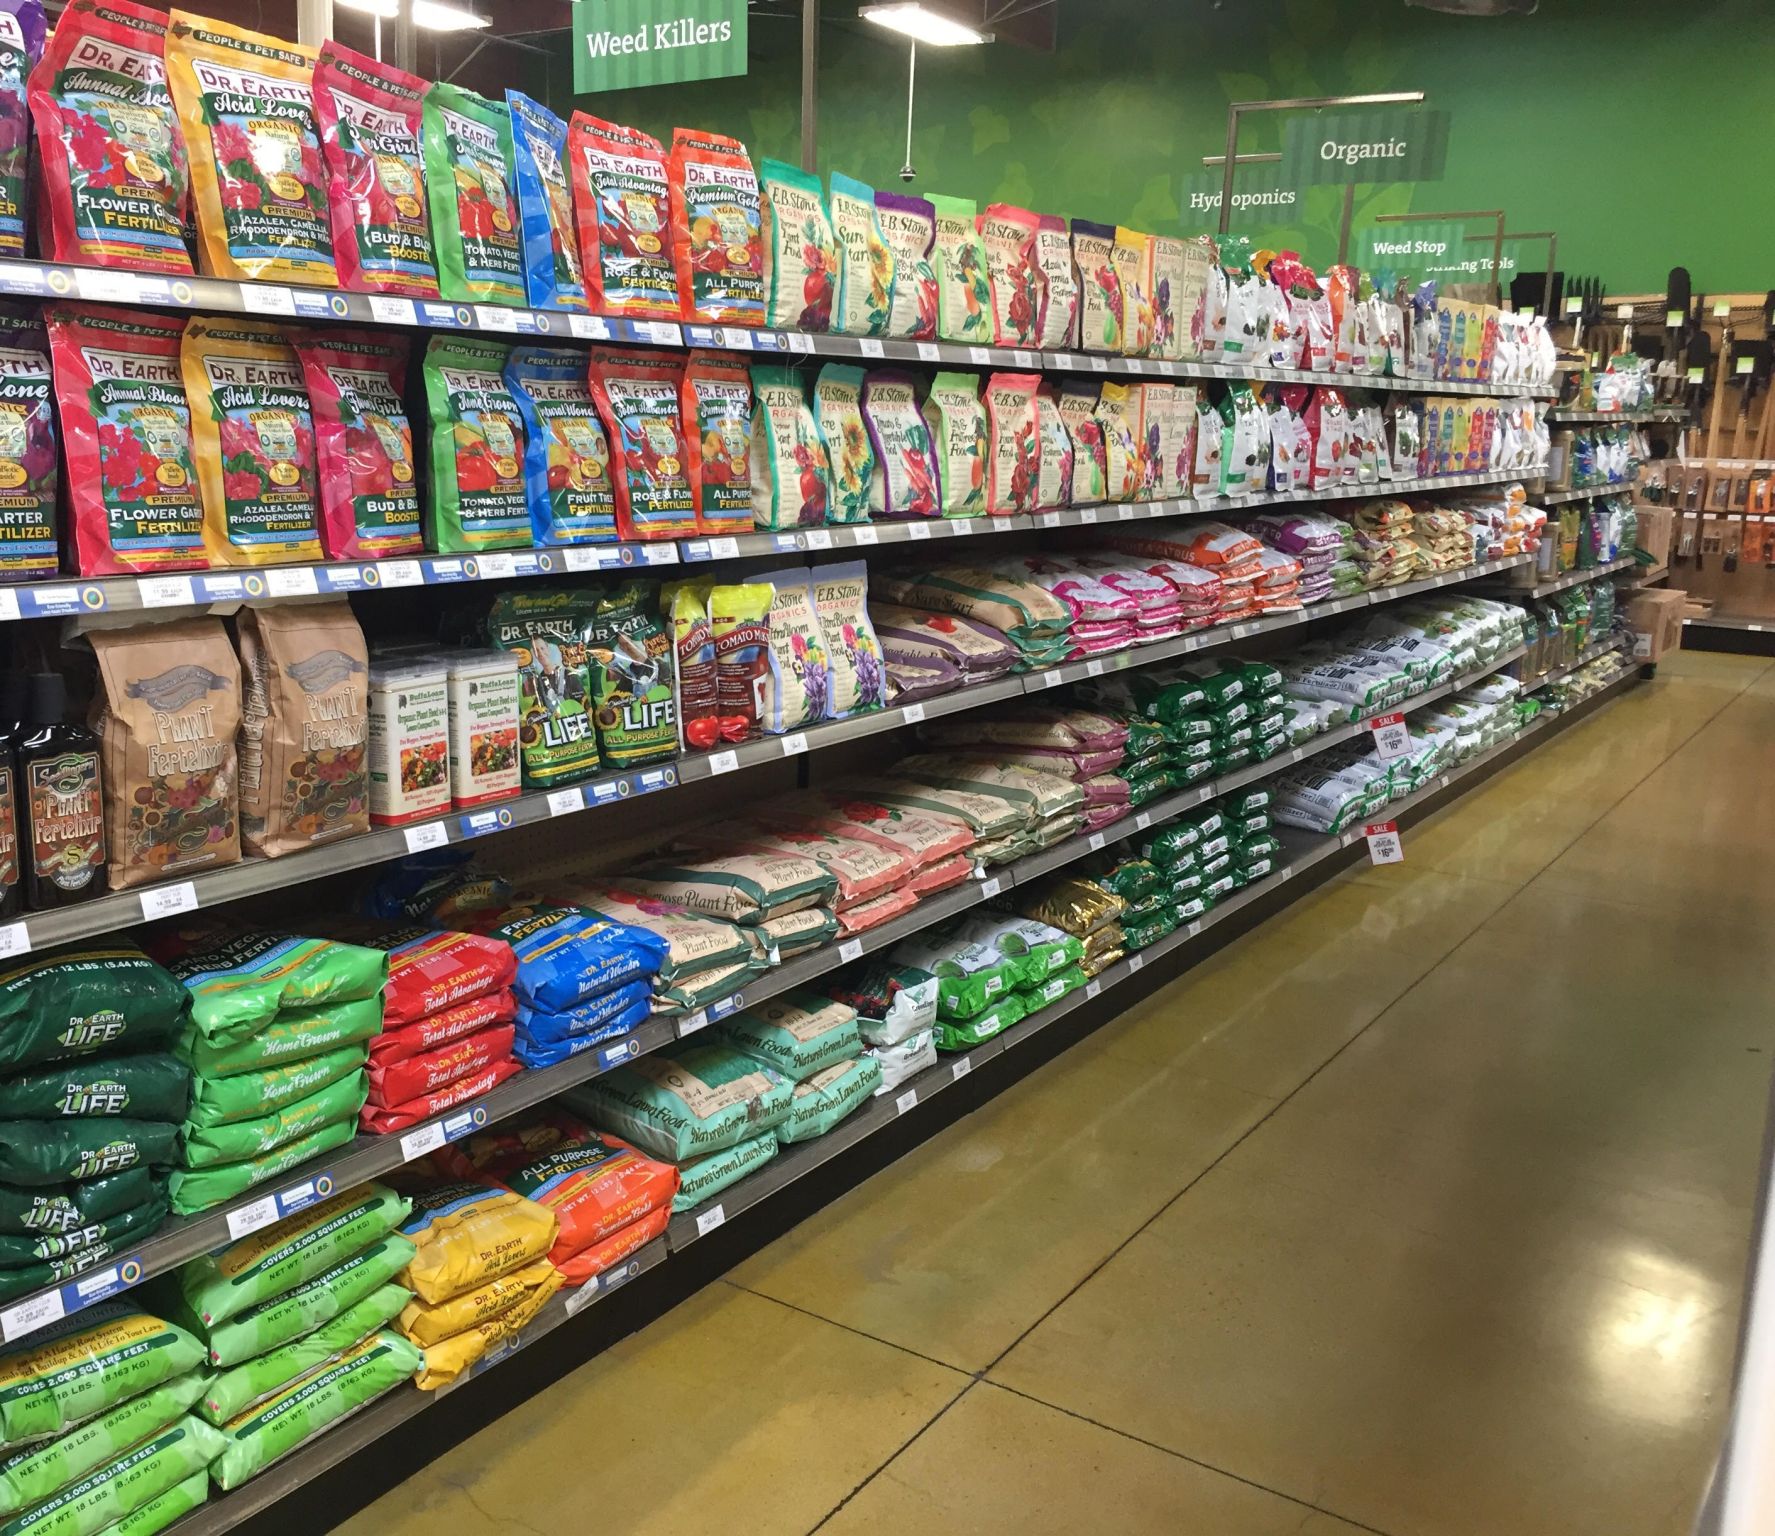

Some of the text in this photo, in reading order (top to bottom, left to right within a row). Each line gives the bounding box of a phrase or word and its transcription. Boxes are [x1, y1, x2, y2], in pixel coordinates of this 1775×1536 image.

[101, 9, 138, 27] PEOPLE
[199, 31, 301, 65] PEOPLE & PET SAFE
[586, 18, 732, 58] Weed Killers
[64, 72, 127, 99] Annual
[340, 63, 388, 92] PEOPLE &
[241, 77, 312, 101] EARTH
[214, 93, 256, 114] Acid
[461, 123, 496, 149] EARTH
[1320, 137, 1407, 165] Organic
[595, 173, 618, 189] Total
[77, 194, 149, 214] FLOWER
[1190, 188, 1296, 209] Hydoponics
[267, 207, 313, 218] PREMIUM
[230, 227, 309, 239] RHODODENDRON
[371, 231, 401, 245] BUD
[839, 226, 864, 245] Sure
[1373, 241, 1446, 256] Weed Stop
[469, 257, 502, 269] & HERB
[605, 267, 651, 278] ROSE &
[705, 278, 727, 288] ALL
[14, 319, 41, 330] SAFE
[221, 386, 310, 411] Acid Lovers
[133, 407, 176, 418] ORGANIC
[250, 411, 293, 422] ORGANIC
[152, 495, 193, 504] PREMIUM
[266, 494, 307, 502] PREMIUM
[567, 494, 598, 505] FRUIT
[632, 491, 662, 502] ROSE
[714, 489, 731, 499] ALL
[110, 507, 177, 521] FLOWER
[367, 500, 406, 512] BUD &
[465, 507, 506, 518] & HERB
[230, 511, 311, 524] RHODODENDRON &
[266, 521, 311, 530] FERTILIZER
[716, 632, 753, 652] TOMATO
[624, 700, 675, 731] LIFE
[1378, 715, 1396, 726] SALE
[542, 713, 593, 748] LIFE
[606, 732, 658, 744] ALL PURPOSE
[528, 747, 579, 762] ALL PURPOSE
[1372, 824, 1388, 834] SALE
[771, 866, 814, 885] Plant Food
[684, 889, 752, 913] Plant Food
[796, 914, 815, 924] Food
[682, 934, 729, 956] Plant Food
[6, 977, 32, 992] NET
[35, 967, 59, 979] WT.
[77, 961, 102, 971] LBS.
[105, 960, 131, 969] (5.44
[133, 960, 152, 969] KG)
[578, 958, 641, 995] Natural Wonder
[424, 974, 496, 1013] Total Advantage
[63, 1022, 122, 1047] LIFE
[422, 1011, 497, 1046] Total Advantage
[262, 1029, 341, 1056] Home Grown
[292, 1066, 330, 1087] Grown
[91, 1083, 126, 1093] EARTH
[61, 1093, 127, 1115] LIFE
[628, 1093, 656, 1117] Lawn
[770, 1098, 792, 1115] Food
[78, 1152, 136, 1179] LIFE
[248, 1145, 320, 1184] Home Grown
[521, 1147, 603, 1181] ALL PURPOSE
[562, 1202, 578, 1214] NET
[24, 1207, 82, 1232] LIFE
[39, 1223, 100, 1258] LIFE
[260, 1205, 367, 1271] COVERS 2,000 SQUARE FEET
[268, 1267, 286, 1281] NET
[114, 1334, 125, 1345] To
[48, 1343, 150, 1388] 2,000 SQUARE FEET
[57, 1359, 150, 1400] 18 LBS. (8.163 KG)
[260, 1354, 372, 1424] COVERS 2,000 SQUARE FEET
[271, 1401, 316, 1433] NET 18
[19, 1400, 152, 1479] NET WT. 18 LBS. KG)
[20, 1443, 158, 1527] COVERS 2,000 SQUARE FEET
[55, 1459, 161, 1525] WT. 18 LBS. KG)
